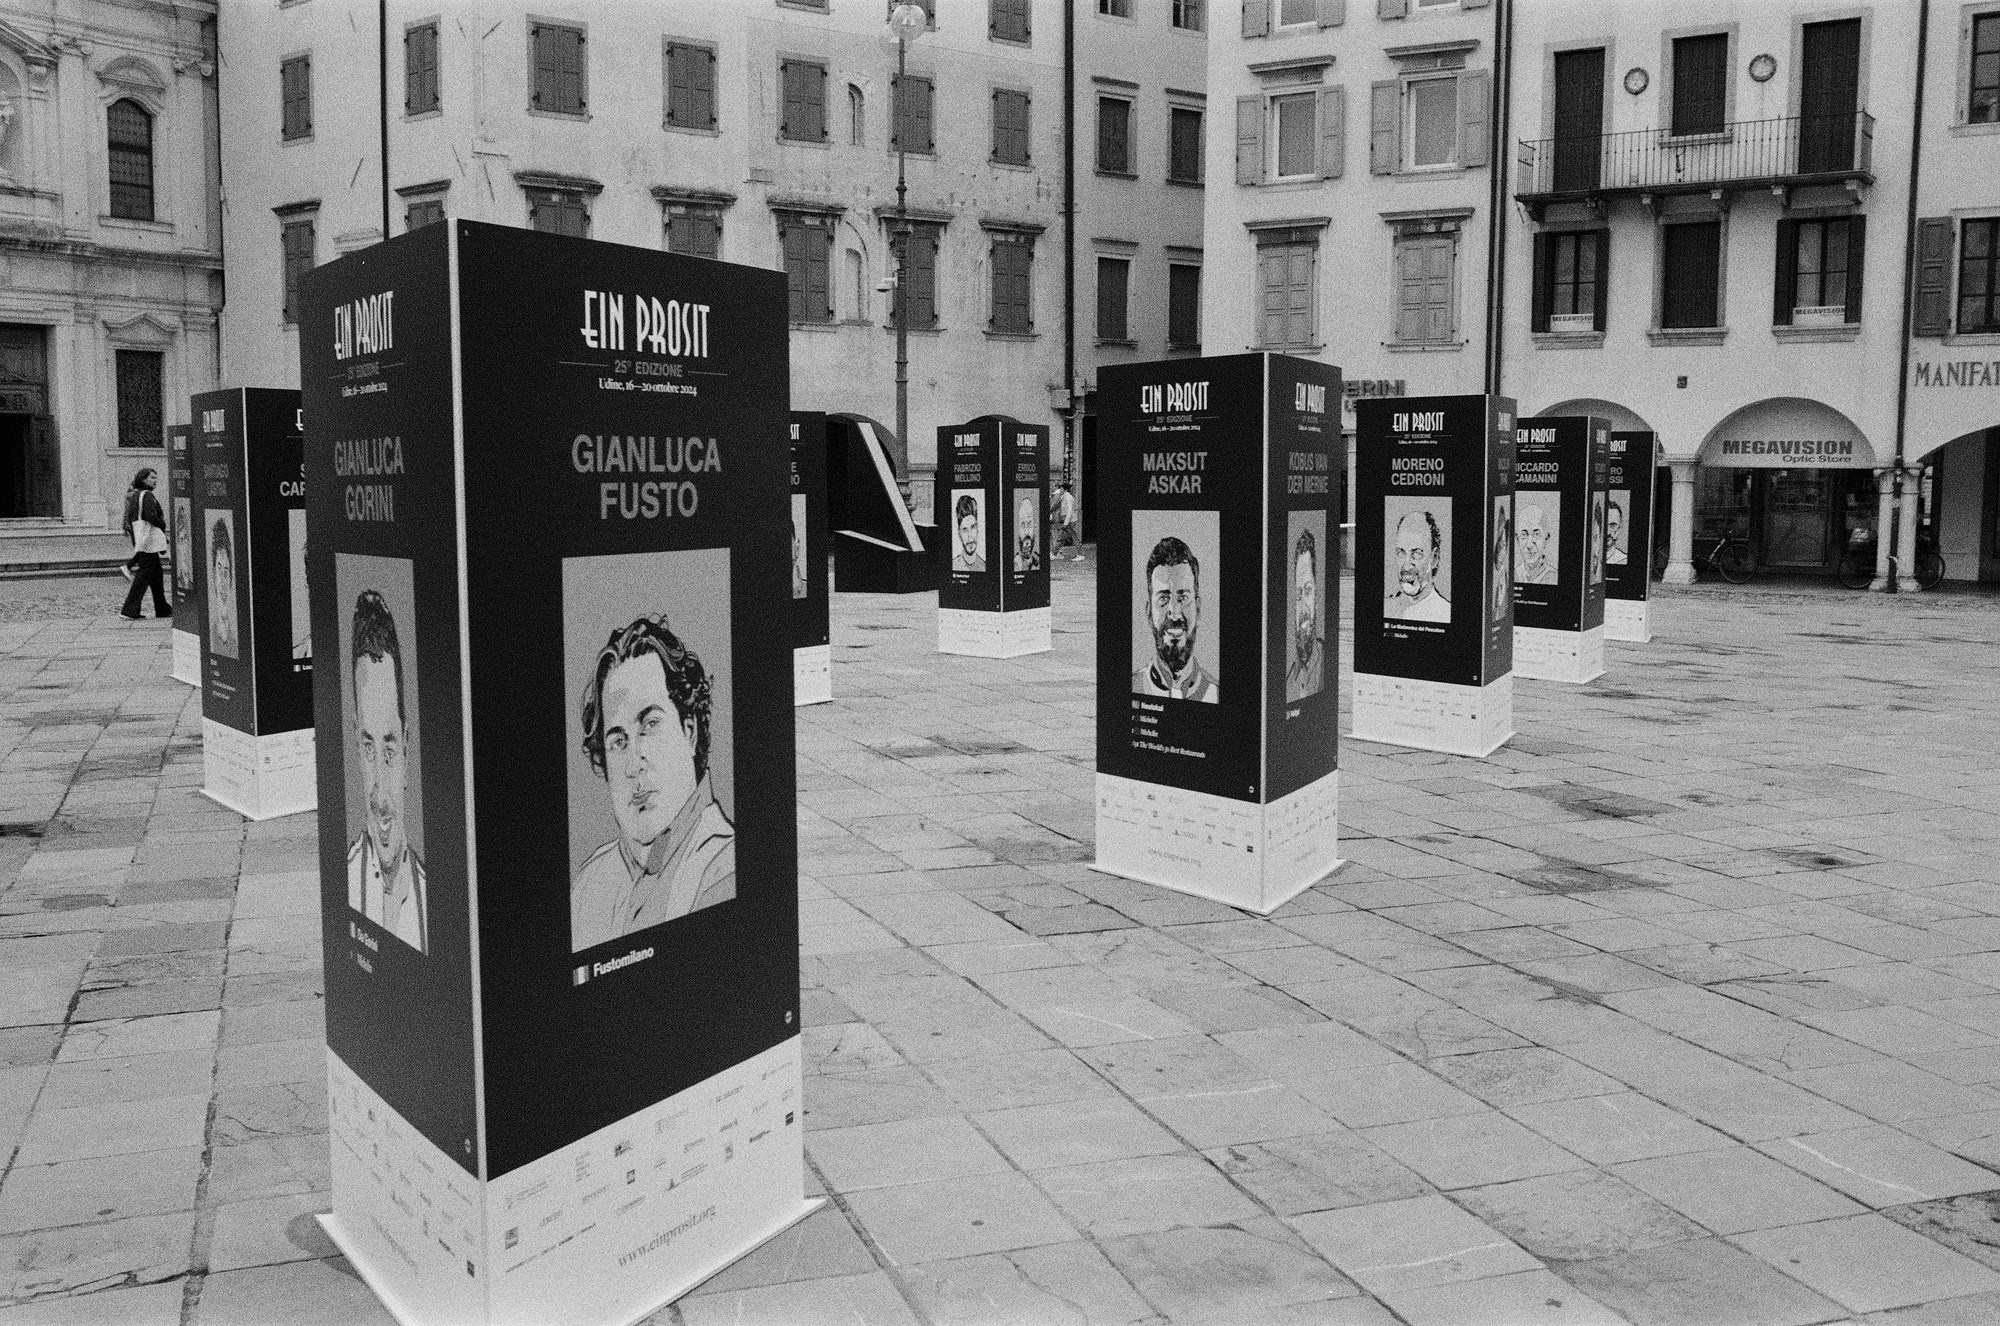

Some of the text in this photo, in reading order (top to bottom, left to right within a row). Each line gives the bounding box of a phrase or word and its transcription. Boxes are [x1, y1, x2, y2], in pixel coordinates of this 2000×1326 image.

[334, 291, 393, 360] EIN PROSIT
[580, 290, 710, 358] EIN PROSIT
[635, 361, 682, 377] EDIZIONE
[1140, 382, 1210, 413] EIN PROSIT
[1295, 382, 1306, 411] EIN
[1342, 380, 1405, 397] ERINI
[1392, 412, 1445, 431] EIN PROSIT
[1516, 428, 1557, 443] EIN PROSIT
[335, 436, 404, 477] GIANLUCA
[571, 434, 722, 473] GIANLUCA
[1722, 440, 1853, 454] MEGAVISION
[954, 464, 981, 473] FABRIZIO
[1143, 452, 1208, 471] MAKSUT
[1392, 458, 1444, 471] MORENO
[1516, 463, 1559, 472] ICCARDO
[1782, 454, 1852, 464] Optic Store
[1148, 475, 1201, 493] ASKAR
[1391, 473, 1445, 486] CEDRONI
[346, 485, 394, 521] GORINI
[601, 480, 698, 519] FUSTO
[593, 947, 655, 977] Fustomilano
